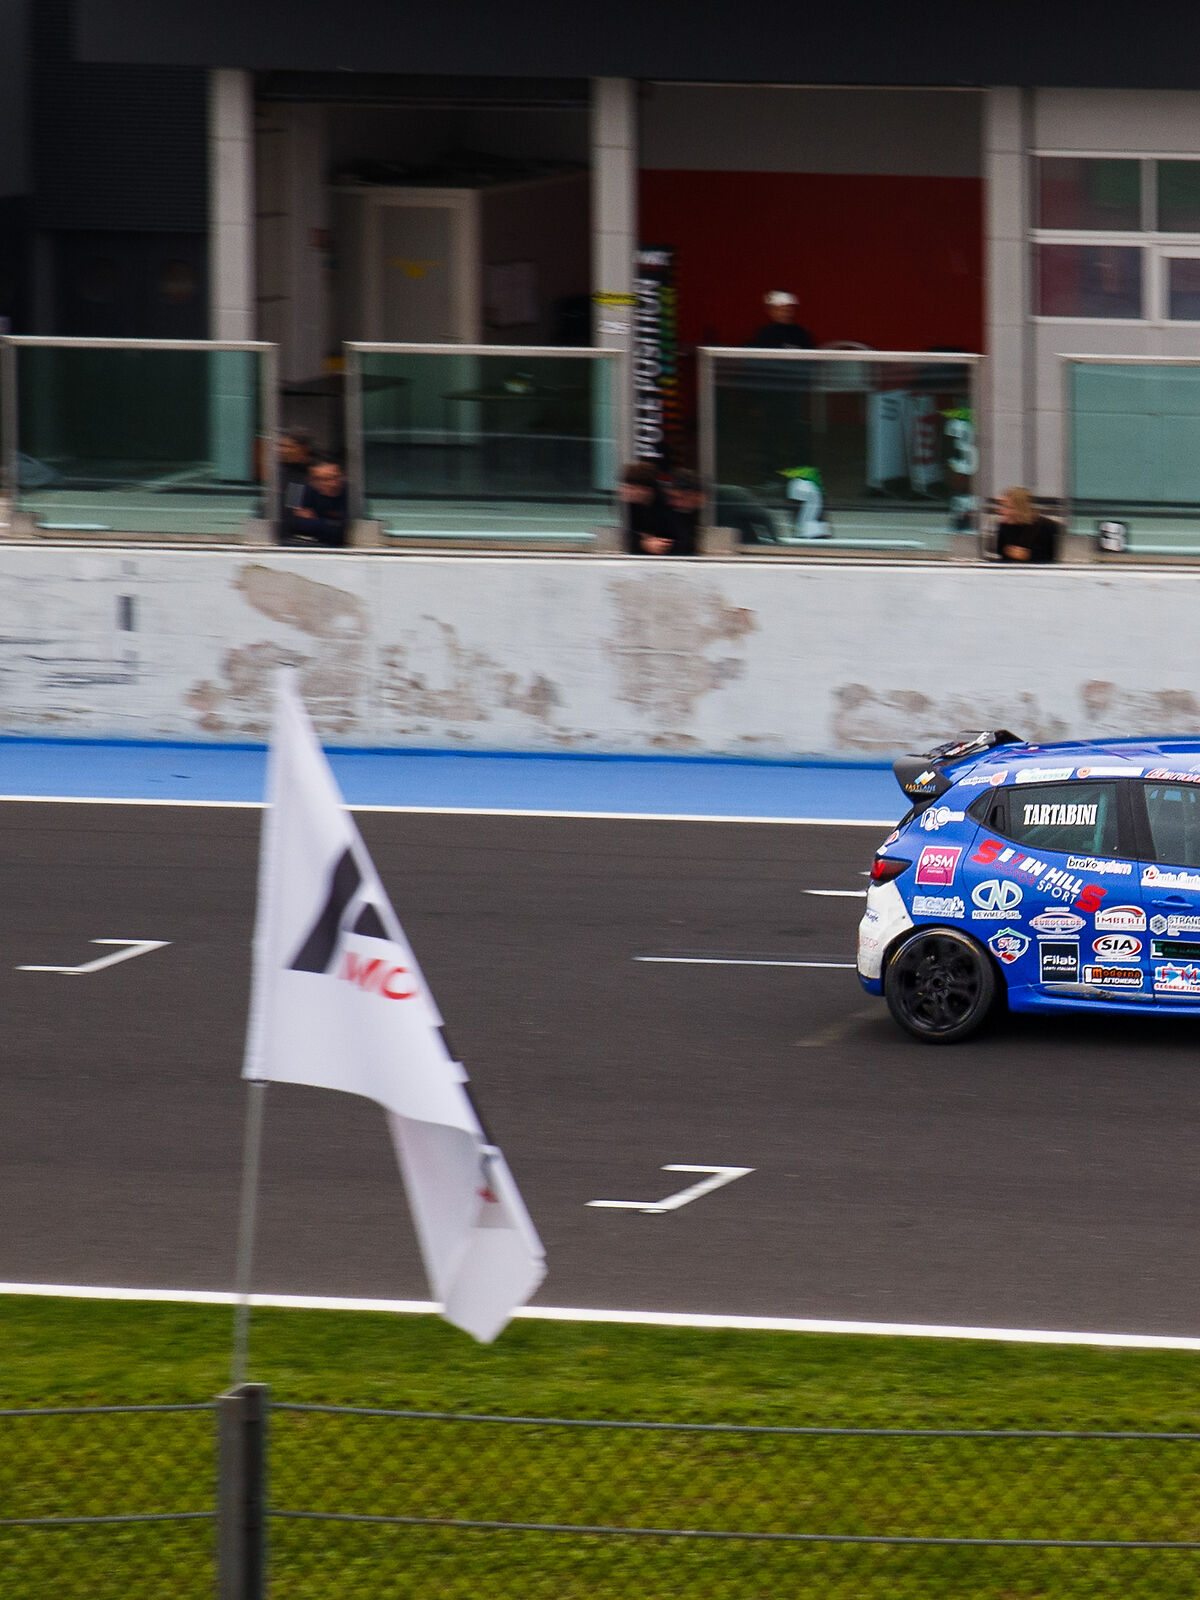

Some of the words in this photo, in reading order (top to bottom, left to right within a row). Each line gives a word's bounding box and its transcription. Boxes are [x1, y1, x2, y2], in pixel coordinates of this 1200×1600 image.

[1023, 803, 1098, 826] TARTABINI
[1036, 880, 1078, 904] SPORT
[1101, 939, 1133, 950] SIA
[1043, 954, 1077, 965] Filab
